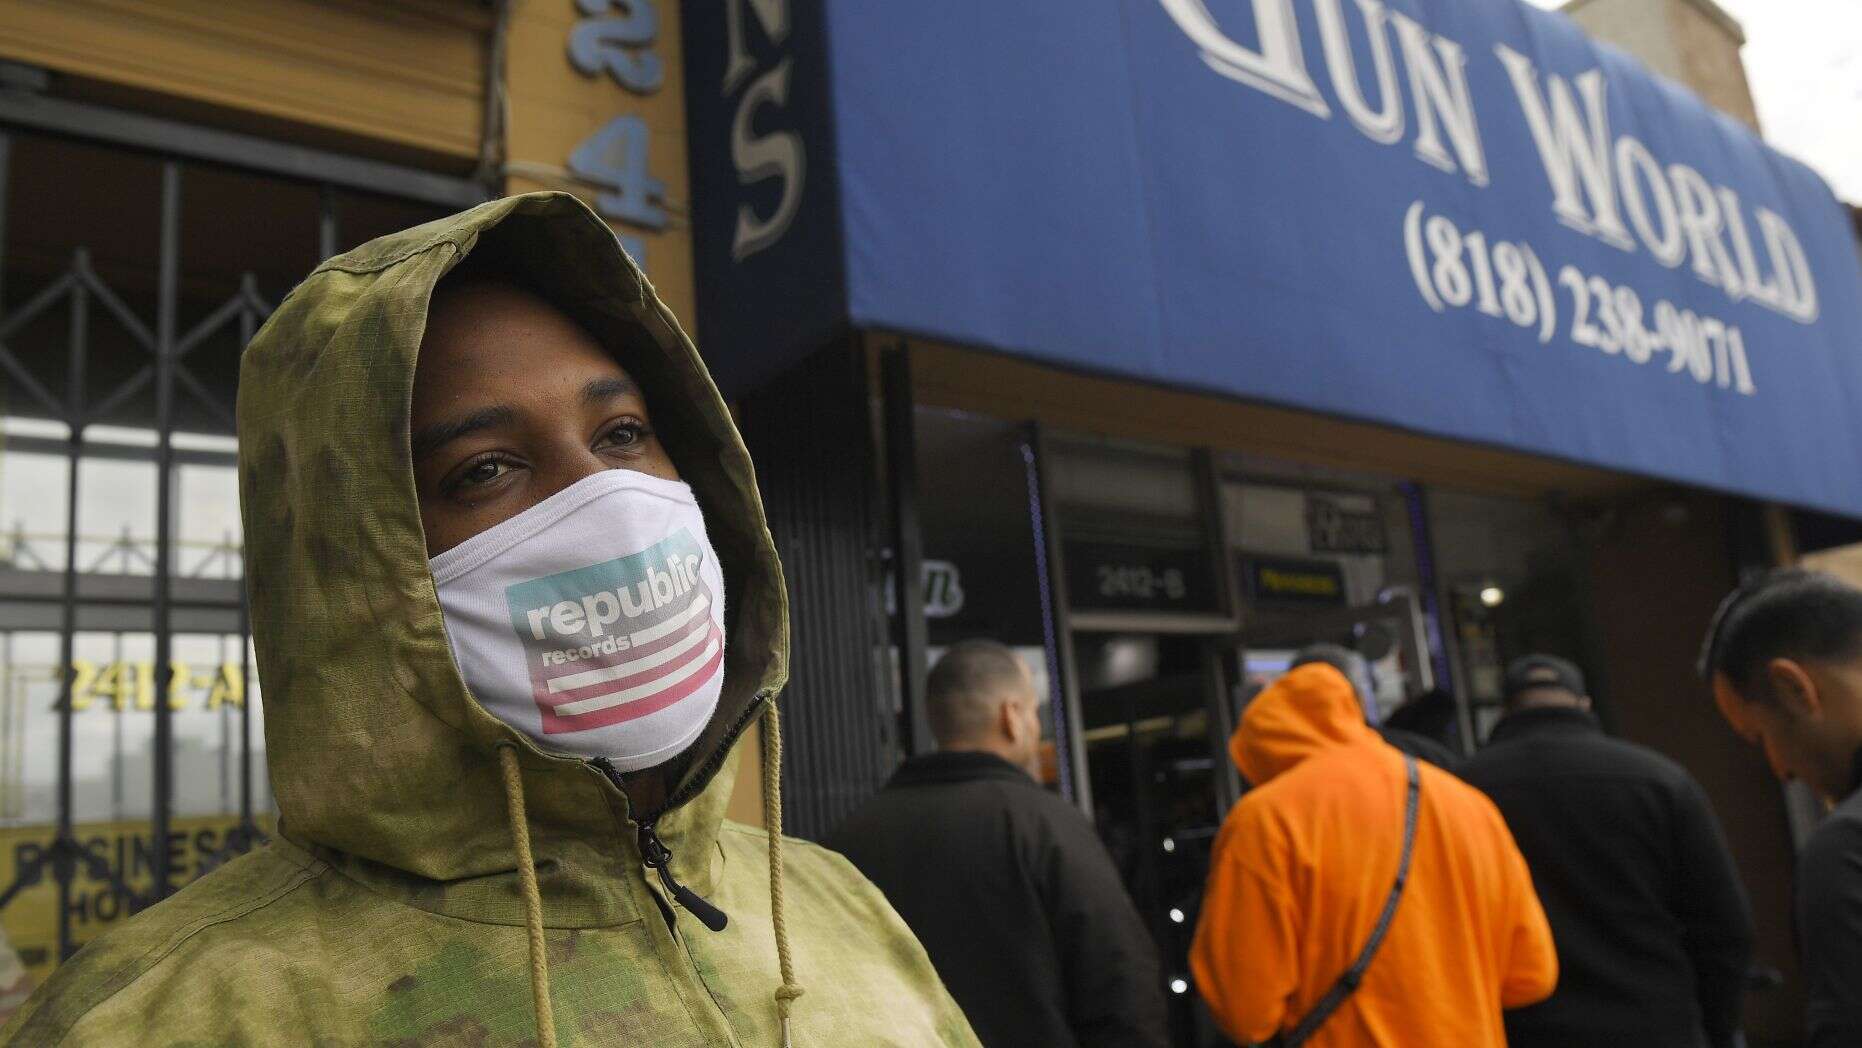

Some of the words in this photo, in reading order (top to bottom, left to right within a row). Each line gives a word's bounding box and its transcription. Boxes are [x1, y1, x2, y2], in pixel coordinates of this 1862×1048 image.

[567, 0, 670, 270] 24
[1493, 40, 1820, 325] WORLD
[1403, 200, 1556, 344] (818)
[1559, 264, 1757, 396] 238-9071
[526, 553, 700, 641] republic
[542, 634, 632, 667] records
